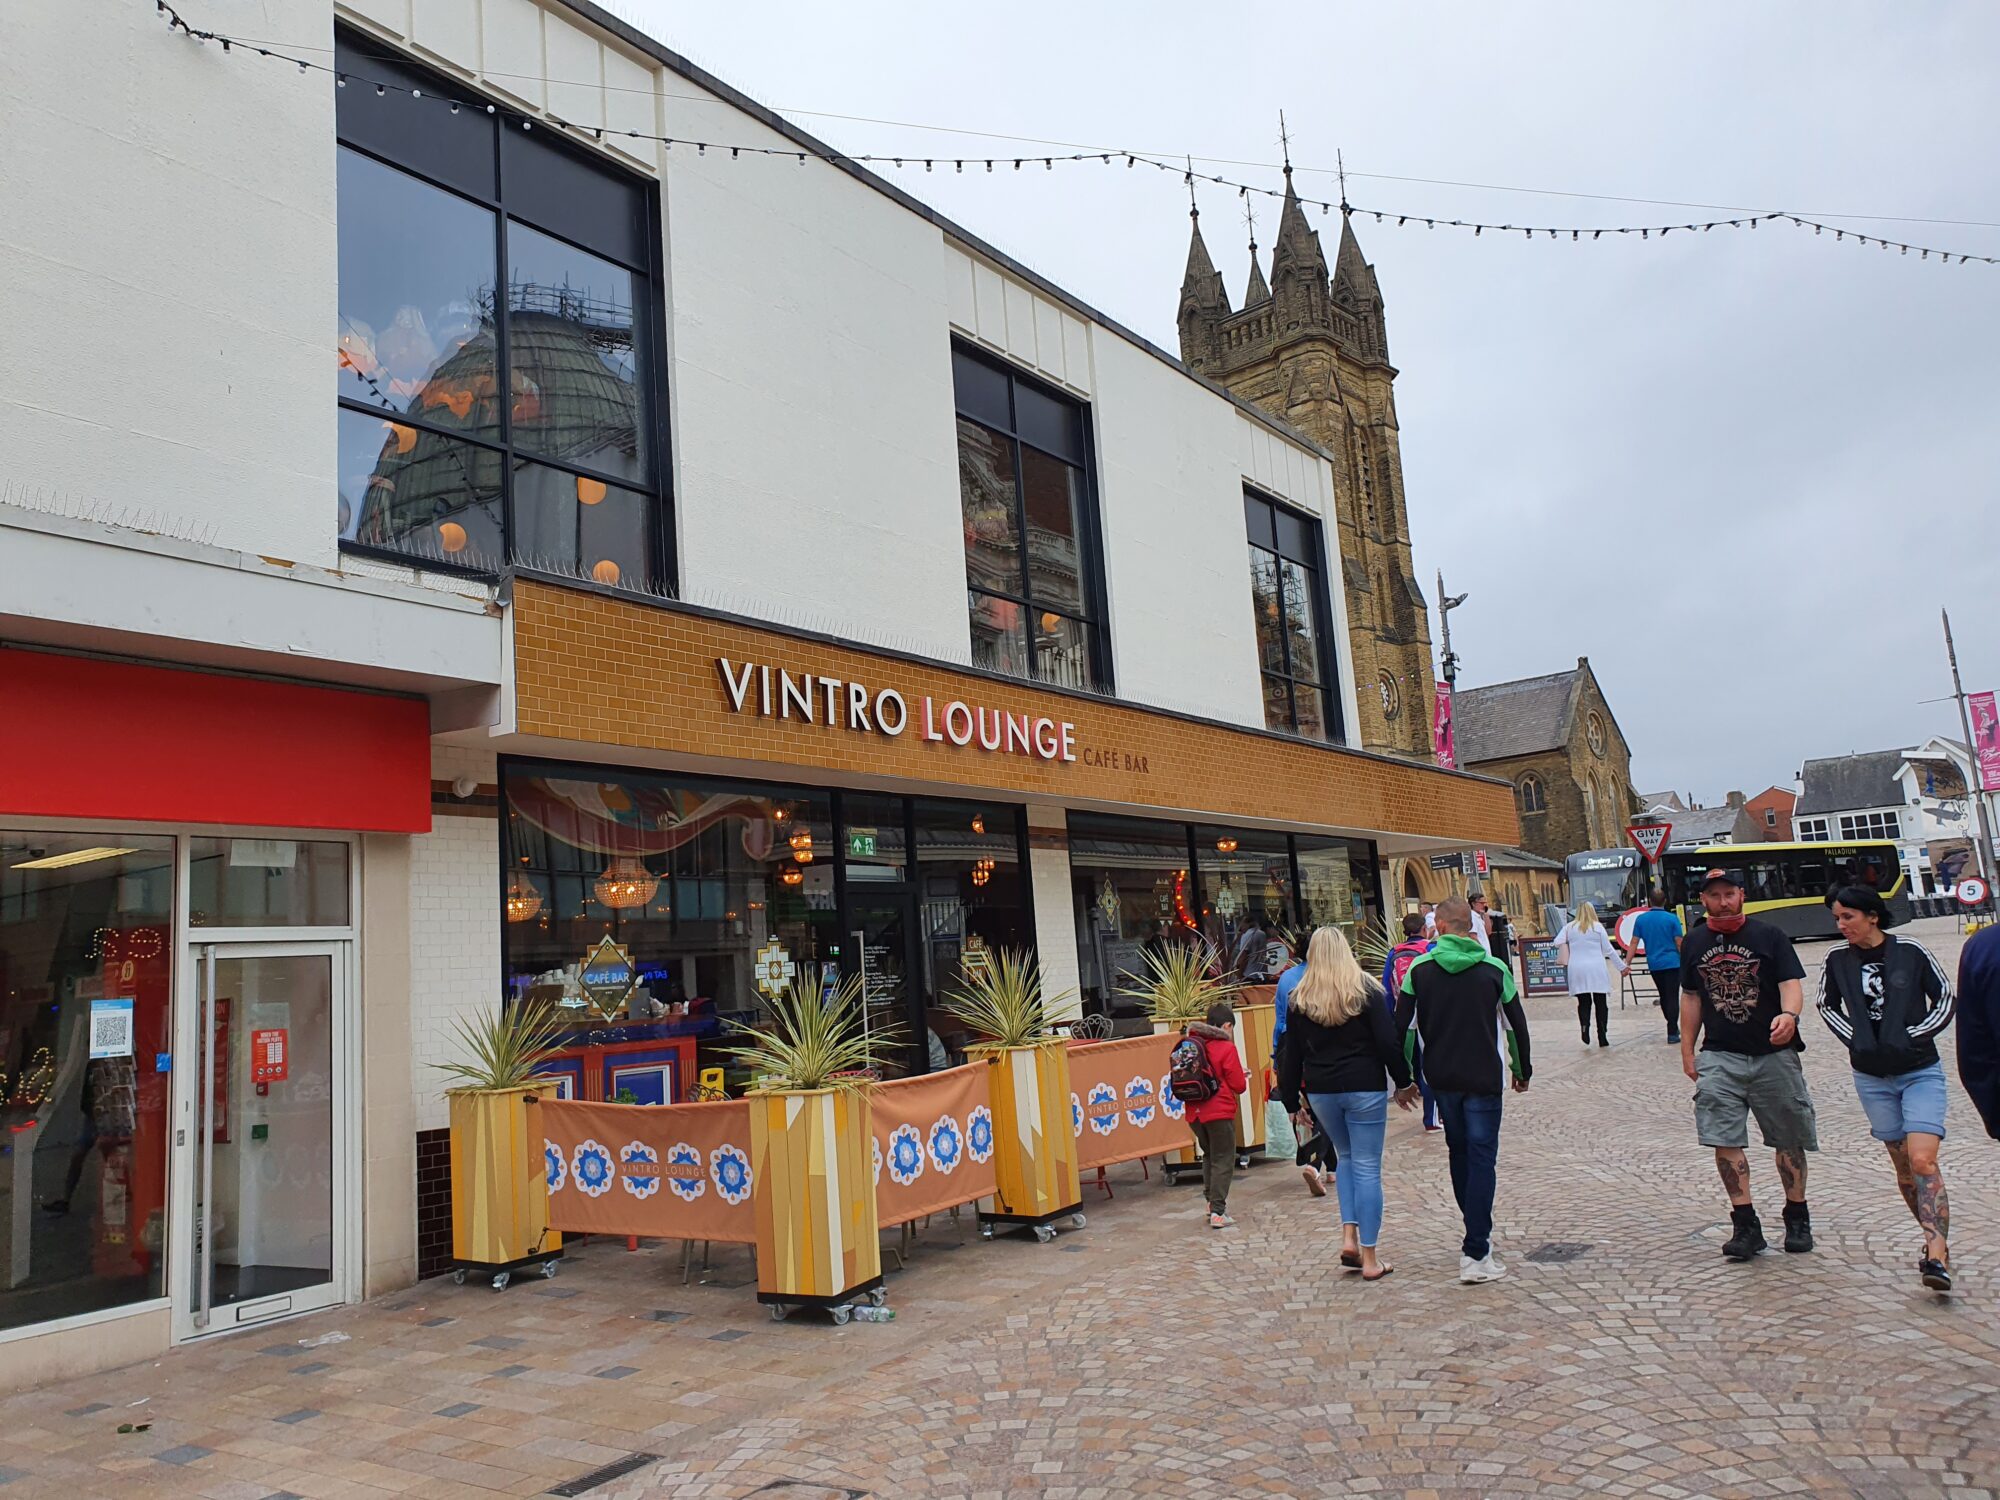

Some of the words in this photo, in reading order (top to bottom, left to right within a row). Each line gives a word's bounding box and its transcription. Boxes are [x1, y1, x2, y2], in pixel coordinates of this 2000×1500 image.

[715, 657, 907, 736] VINTRO
[921, 695, 1077, 763] LOUNGE
[1083, 747, 1120, 769] CAFÉ
[1124, 752, 1151, 774] BAR
[1636, 828, 1663, 838] GIVE
[1618, 855, 1623, 867] 7
[1967, 885, 1976, 896] 5
[1727, 944, 1754, 959] JACK
[585, 970, 610, 985] CAFÉ
[612, 972, 630, 983] BAR
[1088, 1101, 1119, 1115] VINTRO
[1124, 1095, 1157, 1109] LOUNGE
[622, 1163, 660, 1174] VINTRO
[665, 1166, 707, 1177] LOUNGE
